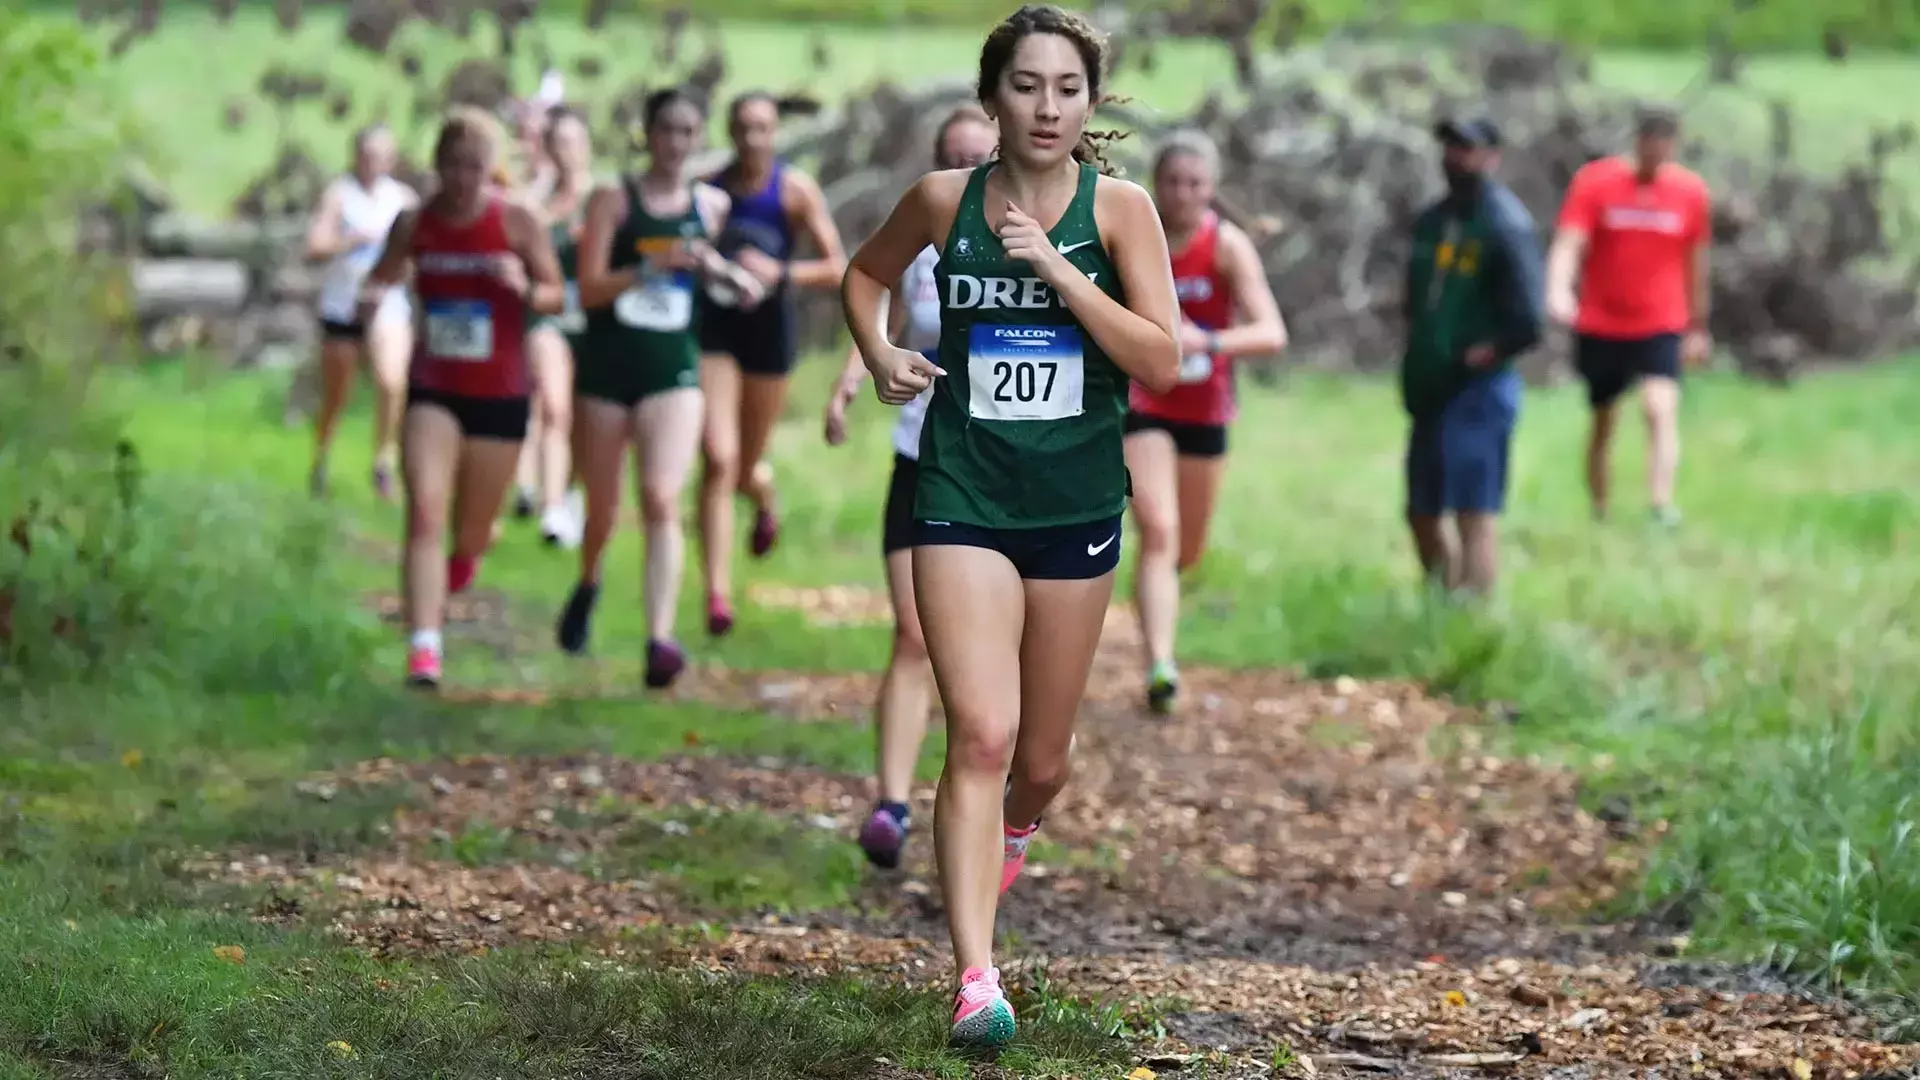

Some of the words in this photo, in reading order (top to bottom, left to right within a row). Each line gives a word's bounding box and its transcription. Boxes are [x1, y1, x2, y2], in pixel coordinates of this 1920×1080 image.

[947, 272, 1098, 309] DRE
[994, 329, 1056, 338] FALCON
[993, 361, 1058, 402] 207
